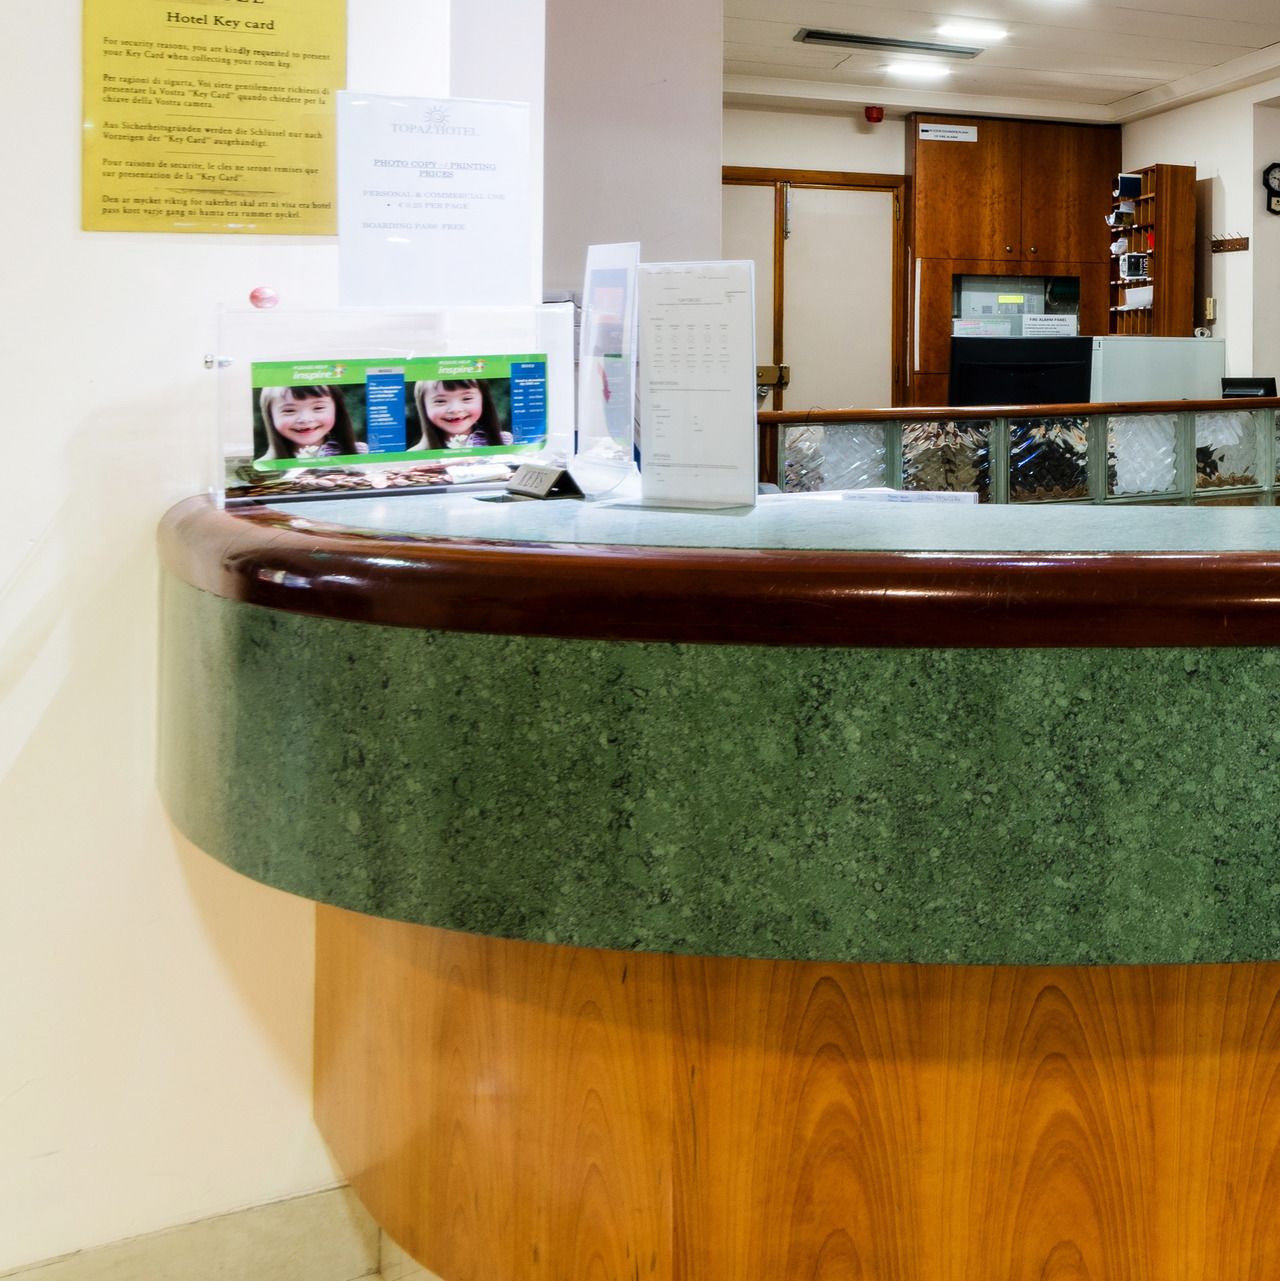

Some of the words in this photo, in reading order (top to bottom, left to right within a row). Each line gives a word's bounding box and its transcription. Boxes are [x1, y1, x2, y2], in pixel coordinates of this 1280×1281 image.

[167, 11, 208, 25] Hotel
[213, 15, 241, 29] Key
[245, 20, 275, 30] card
[103, 37, 118, 45] For
[121, 40, 153, 49] security
[157, 42, 190, 51] reasons,
[225, 46, 250, 56] kindly
[253, 50, 289, 58] requested
[125, 49, 141, 58] Key
[144, 51, 164, 59] Card
[191, 55, 231, 65] collecting
[235, 127, 247, 135] die
[392, 123, 433, 135] TOPAZ
[436, 125, 480, 136] HOTEL
[102, 158, 122, 166] Pour
[158, 160, 168, 168] de
[374, 159, 409, 168] PHOTO
[411, 160, 437, 169] COPY
[450, 162, 497, 171] PRINTING
[419, 170, 454, 178] PRICES
[293, 371, 332, 381] inspire
[438, 366, 473, 376] inspire
